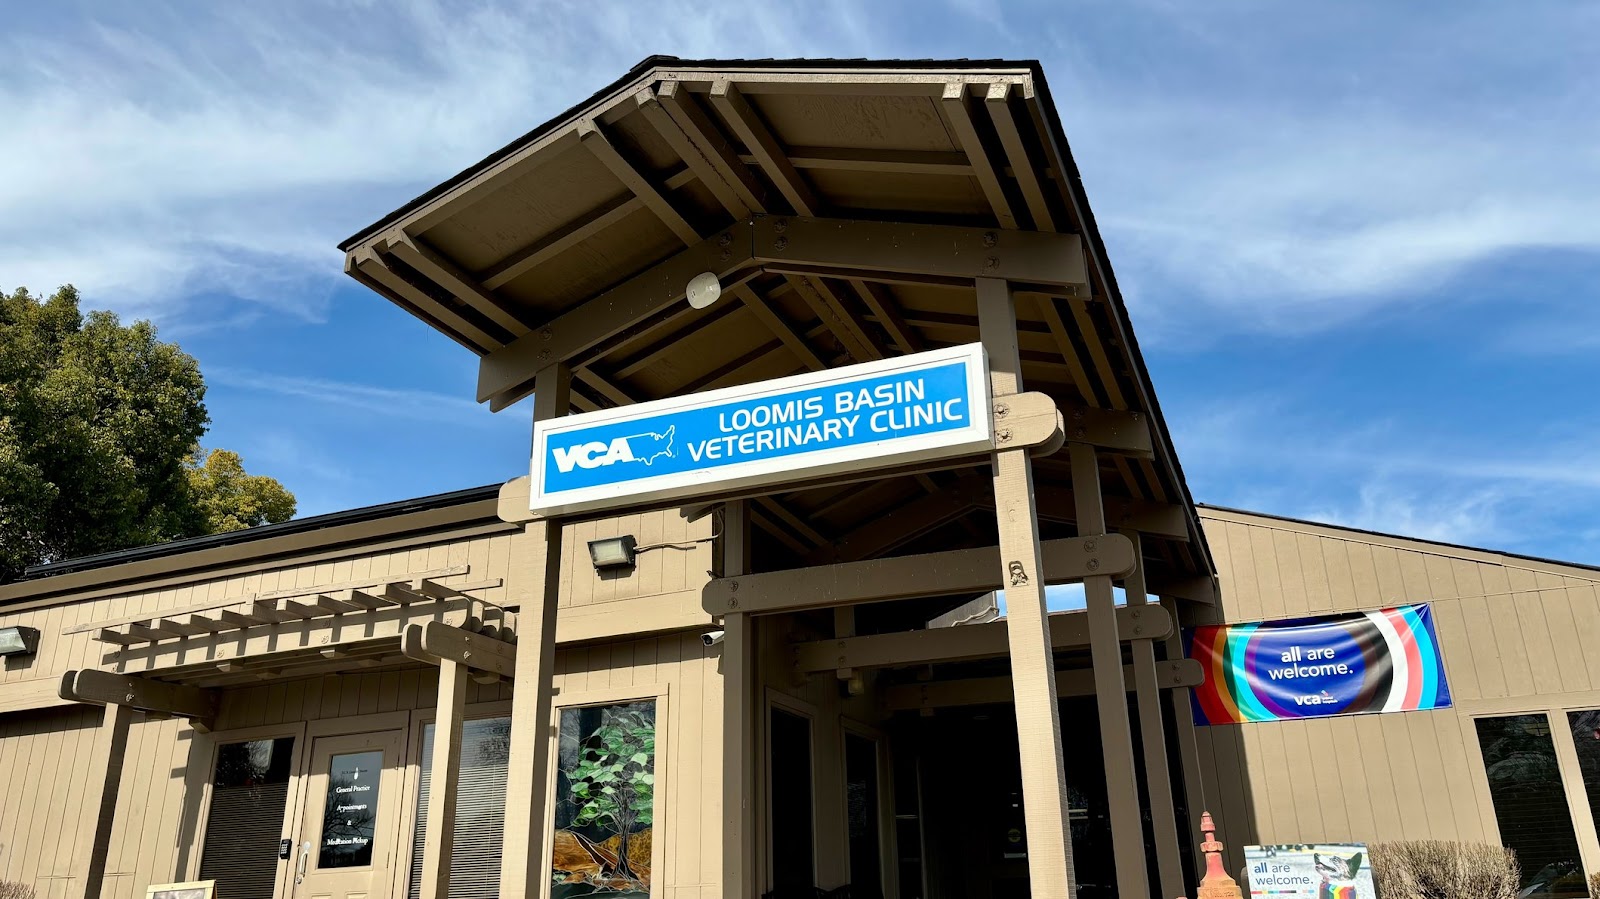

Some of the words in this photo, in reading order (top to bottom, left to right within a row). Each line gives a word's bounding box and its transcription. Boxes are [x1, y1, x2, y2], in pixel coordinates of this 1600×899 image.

[718, 395, 824, 433] LOOMIS
[834, 378, 925, 415] BASIN
[686, 413, 865, 463] VETERINARY
[869, 397, 964, 434] CLINIC
[552, 437, 635, 474] VCA
[1281, 646, 1301, 662] all
[1307, 648, 1335, 661] are
[1268, 663, 1354, 680] welcome.
[1294, 695, 1321, 706] vca
[336, 785, 353, 794] General
[353, 784, 370, 792] Practice
[336, 803, 367, 812] Appointments
[352, 837, 369, 845] Pickup
[1254, 862, 1268, 874] all
[1271, 864, 1290, 873] are
[1255, 874, 1314, 885] welcome.
